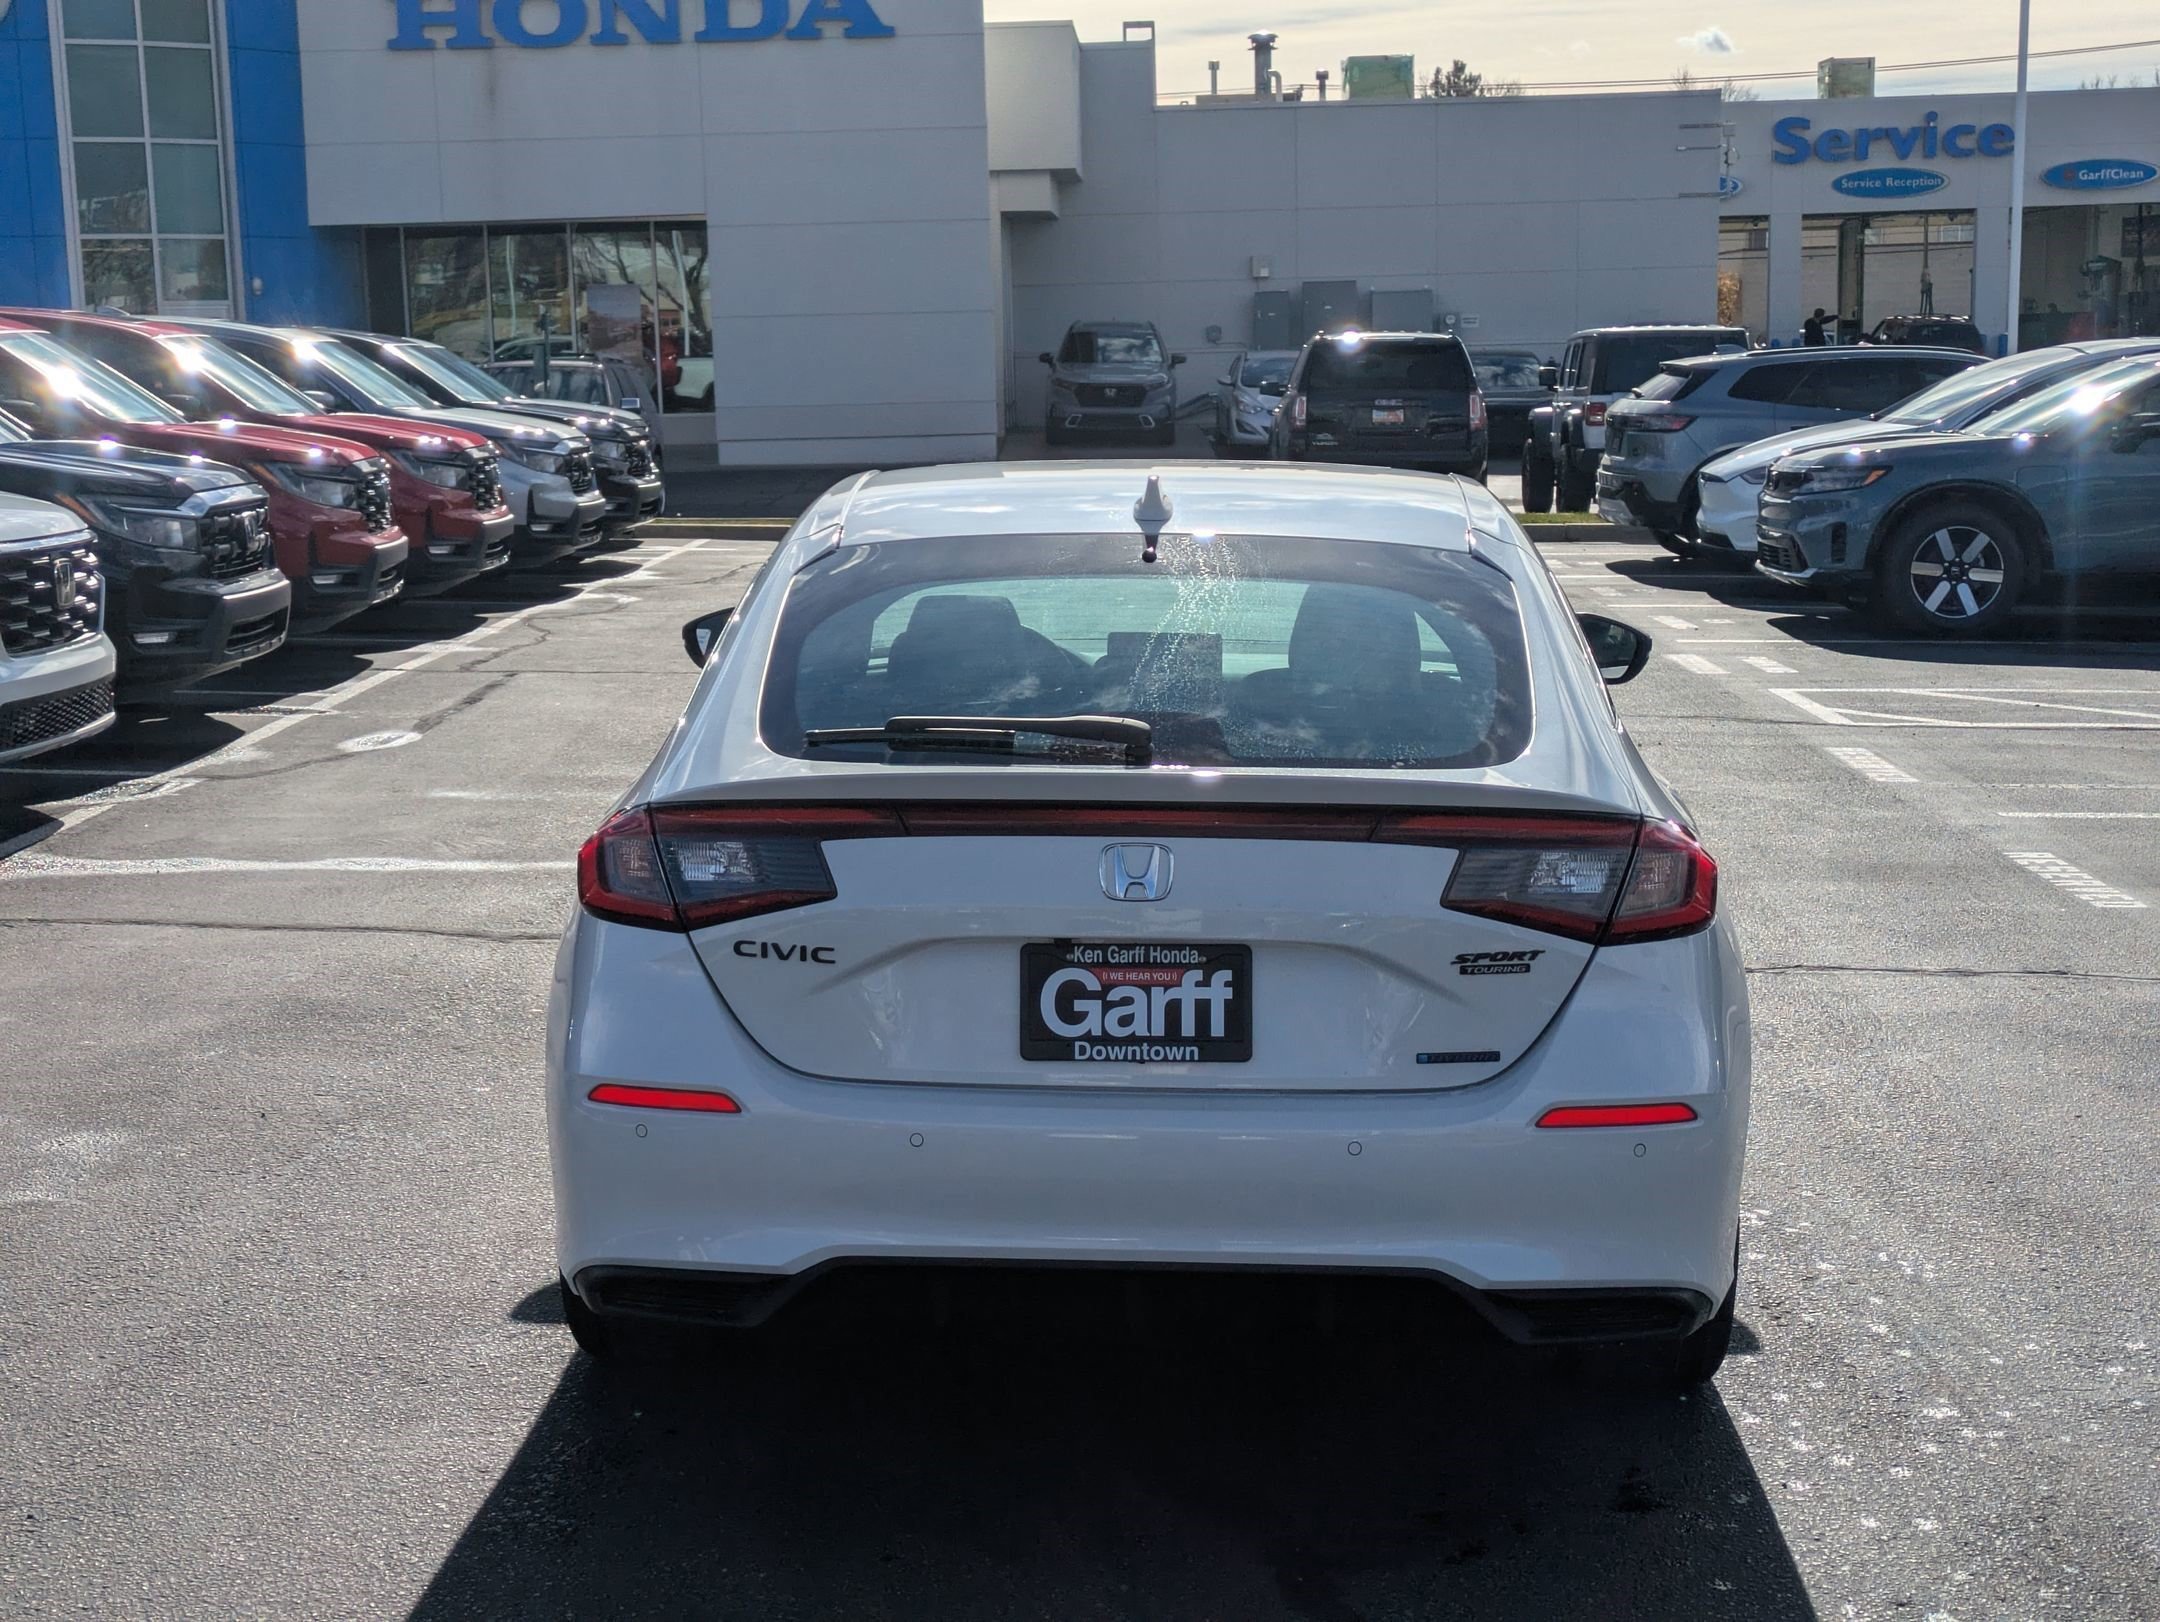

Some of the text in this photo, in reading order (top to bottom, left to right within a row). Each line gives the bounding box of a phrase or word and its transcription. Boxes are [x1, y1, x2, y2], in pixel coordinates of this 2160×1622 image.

[387, 0, 895, 50] HONDA
[1773, 111, 2015, 164] Service
[1840, 175, 1942, 189] Service Reception
[2078, 168, 2144, 181] GarffClean
[733, 940, 836, 964] CIVIC
[1073, 945, 1199, 964] Ken Garff Honda
[1451, 950, 1546, 965] SPORT
[1109, 972, 1171, 981] WE HEAR YOU
[1466, 966, 1526, 974] TOURING
[1040, 967, 1233, 1038] Garff
[1074, 1041, 1199, 1061] Downtown
